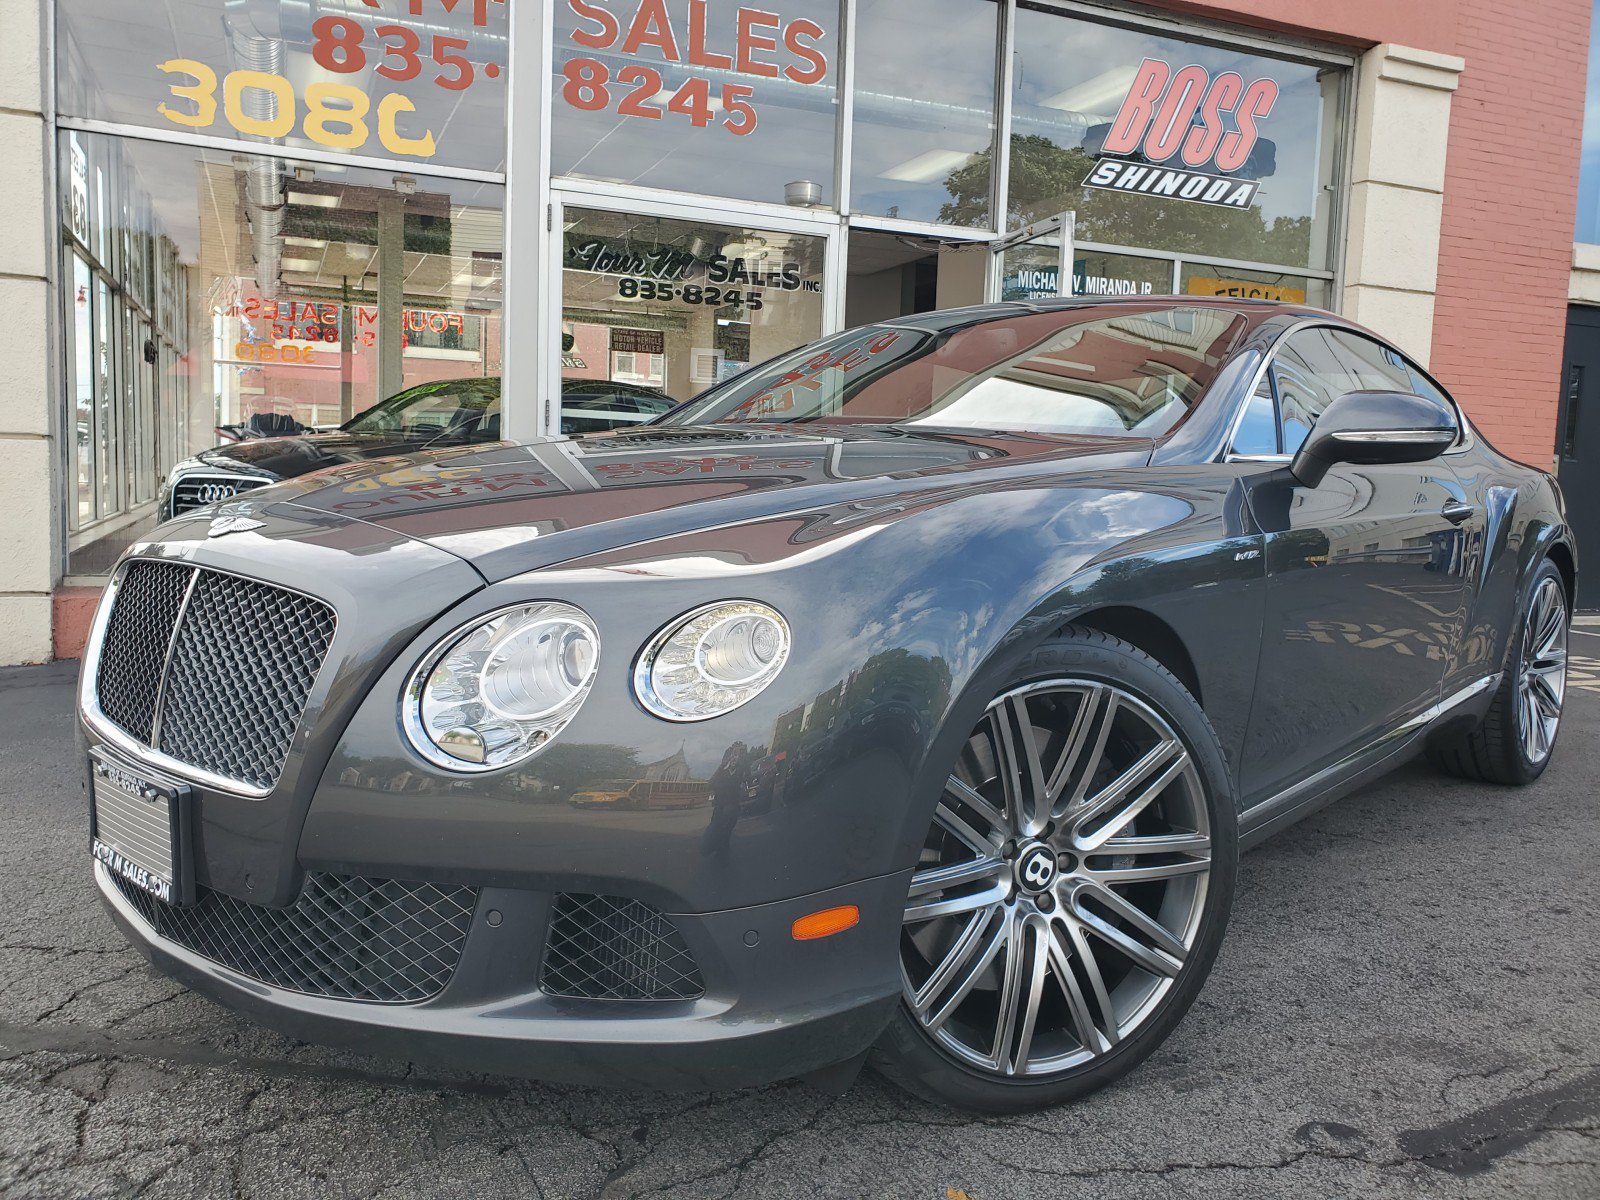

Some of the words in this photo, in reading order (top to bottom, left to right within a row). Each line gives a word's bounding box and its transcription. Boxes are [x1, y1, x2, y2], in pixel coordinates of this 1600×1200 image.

[568, 0, 828, 86] SALES
[562, 57, 760, 137] 8245
[1100, 57, 1280, 173] BOSS
[1089, 161, 1256, 207] SHINODA
[708, 254, 802, 292] SALES
[803, 280, 823, 294] INC.
[1085, 275, 1137, 295] MIRANDA
